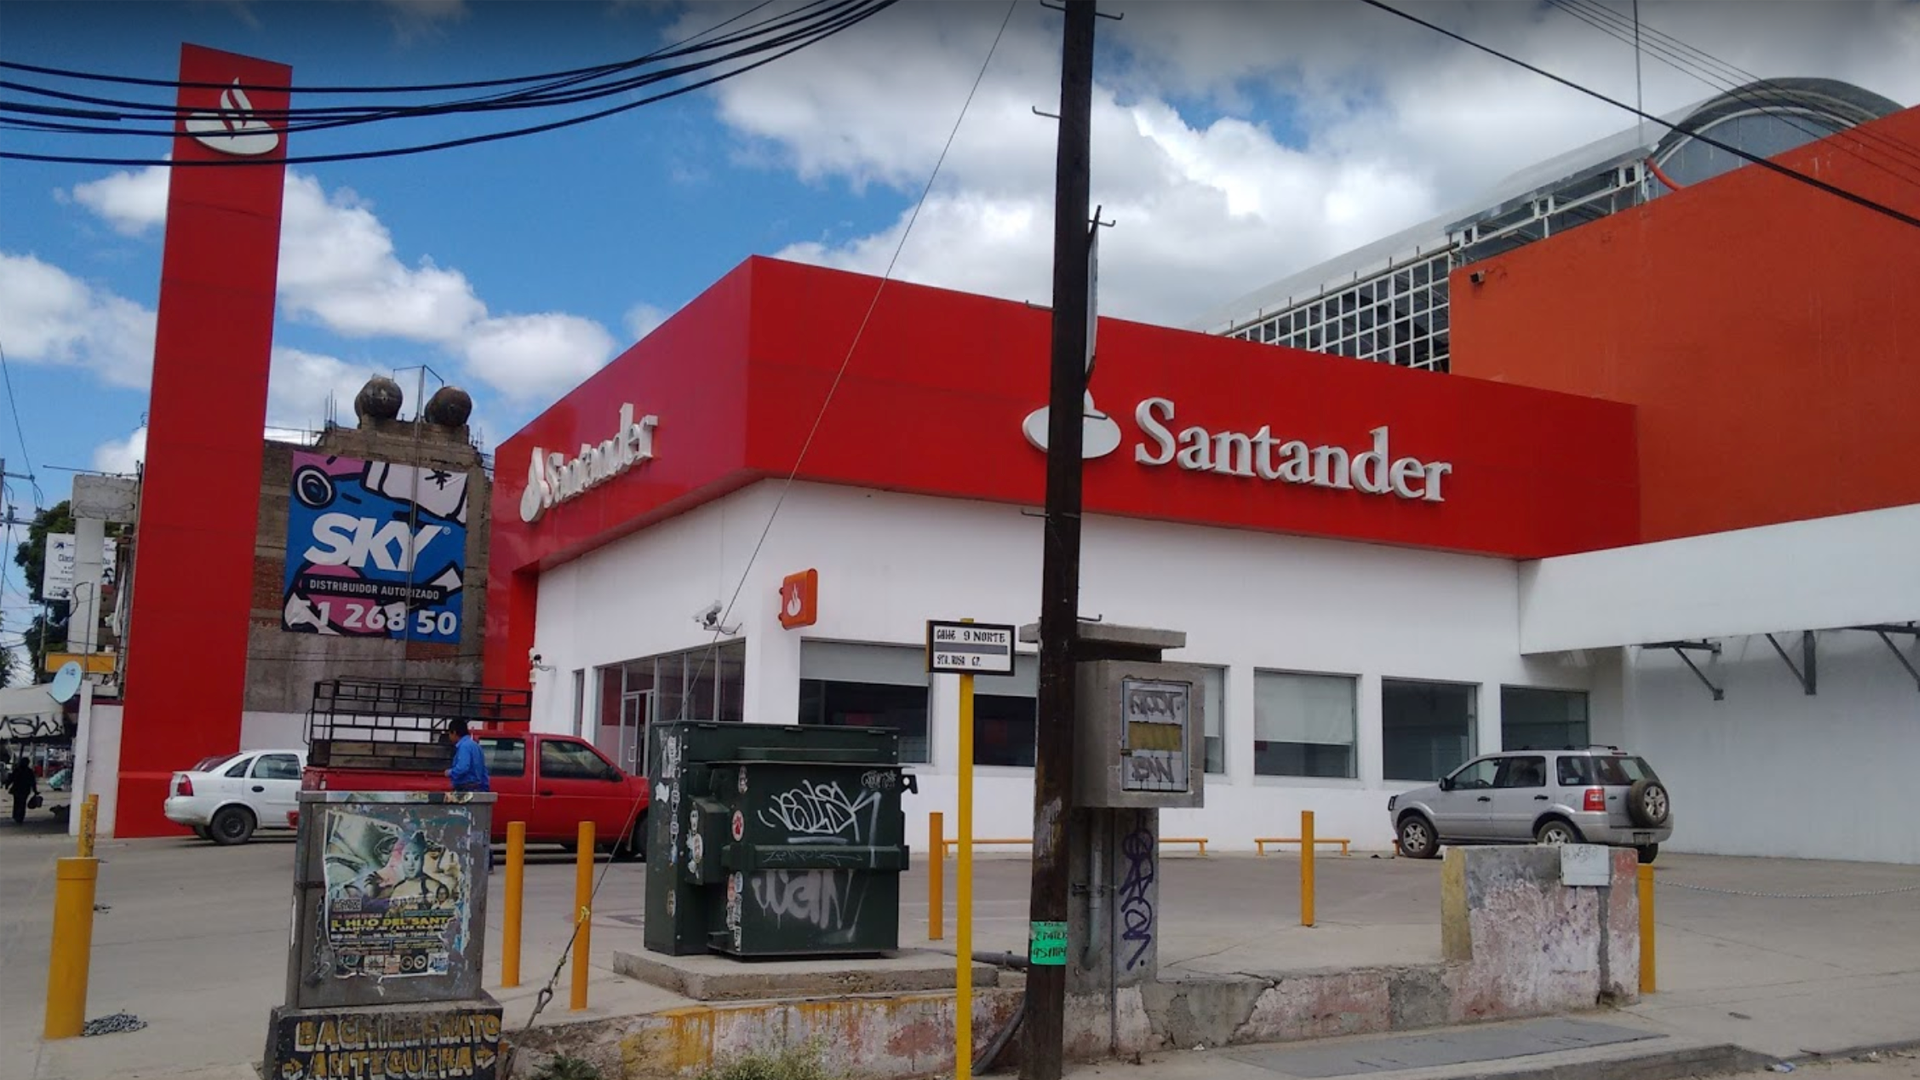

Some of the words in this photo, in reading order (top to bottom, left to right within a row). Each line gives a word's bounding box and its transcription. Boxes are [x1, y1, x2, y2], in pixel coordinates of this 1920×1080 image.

[546, 402, 658, 504] Santander
[1135, 397, 1452, 502] Santander
[303, 512, 443, 572] SKY
[309, 579, 378, 594] DISTRIBUIDOR
[381, 586, 440, 600] AUTORIZADO
[343, 603, 406, 631] 268
[416, 609, 457, 636] 50
[963, 630, 970, 641] 9
[973, 631, 1006, 643] NORTE
[345, 918, 380, 928] HIJO
[383, 918, 407, 926] DEL
[411, 916, 448, 925] SANT
